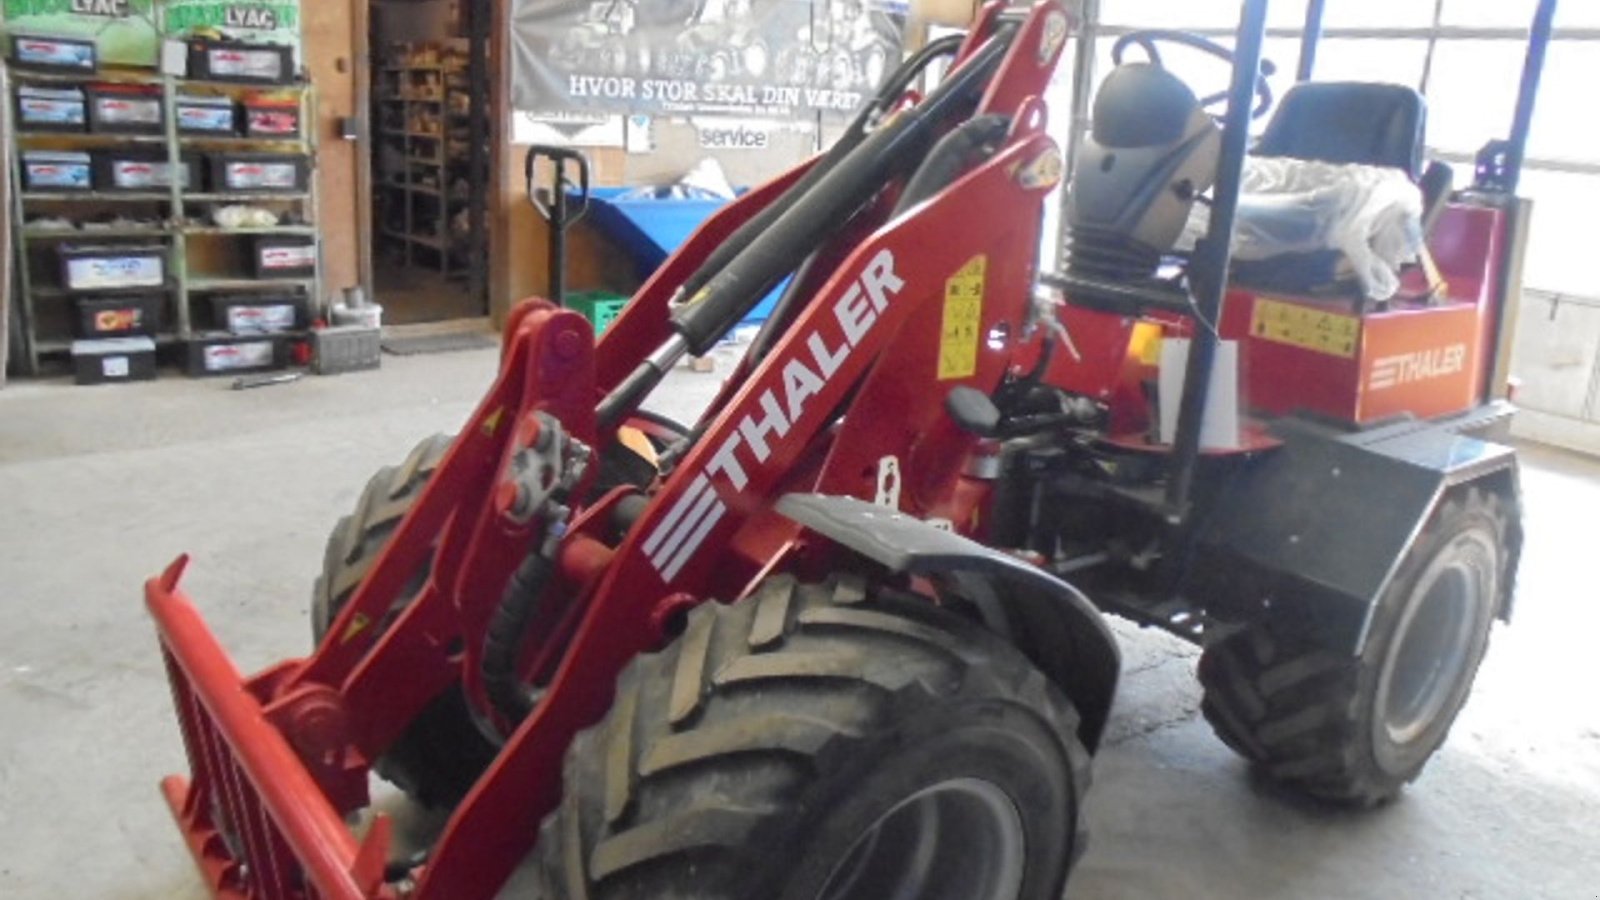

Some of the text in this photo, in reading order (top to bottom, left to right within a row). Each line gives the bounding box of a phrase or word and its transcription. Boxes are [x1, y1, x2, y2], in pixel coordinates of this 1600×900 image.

[225, 6, 271, 28] LYAC
[569, 74, 637, 98] HVOR
[641, 79, 697, 101] STOR
[702, 84, 758, 104] SKAL
[762, 87, 801, 106] DIN
[701, 125, 765, 146] service
[705, 248, 905, 493] THALER
[1397, 344, 1466, 384] THALER
